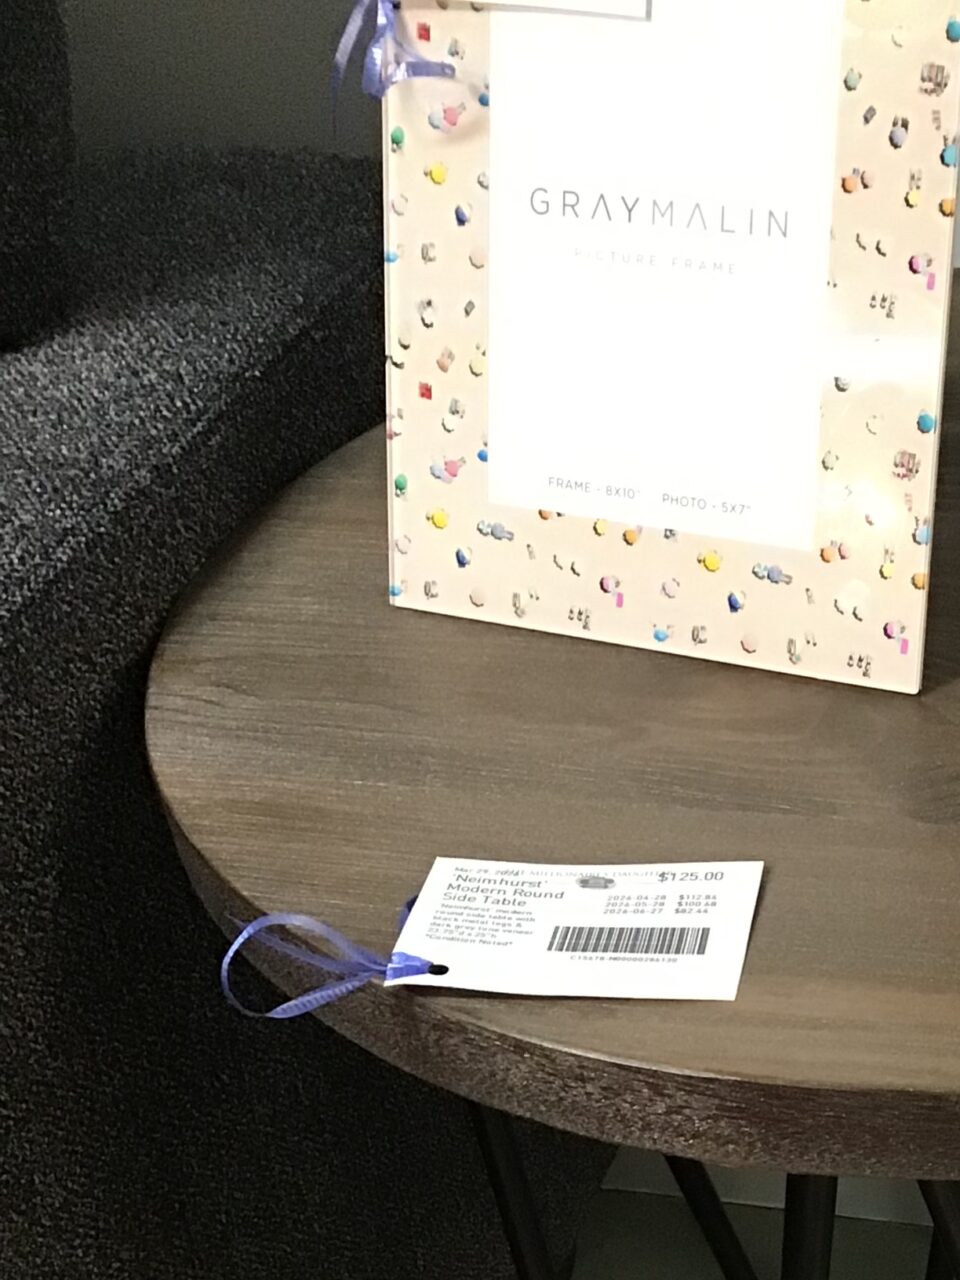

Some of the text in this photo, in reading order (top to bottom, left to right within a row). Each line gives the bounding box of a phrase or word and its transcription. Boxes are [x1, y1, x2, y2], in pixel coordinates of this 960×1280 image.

[529, 186, 789, 240] GRAYMALIN
[574, 247, 736, 275] PICTURE FRAME
[548, 476, 592, 494] FRAME
[661, 492, 708, 511] PHOTO
[657, 871, 725, 884] $125.00
[442, 891, 527, 908] Side Table
[447, 883, 565, 900] Modern Round
